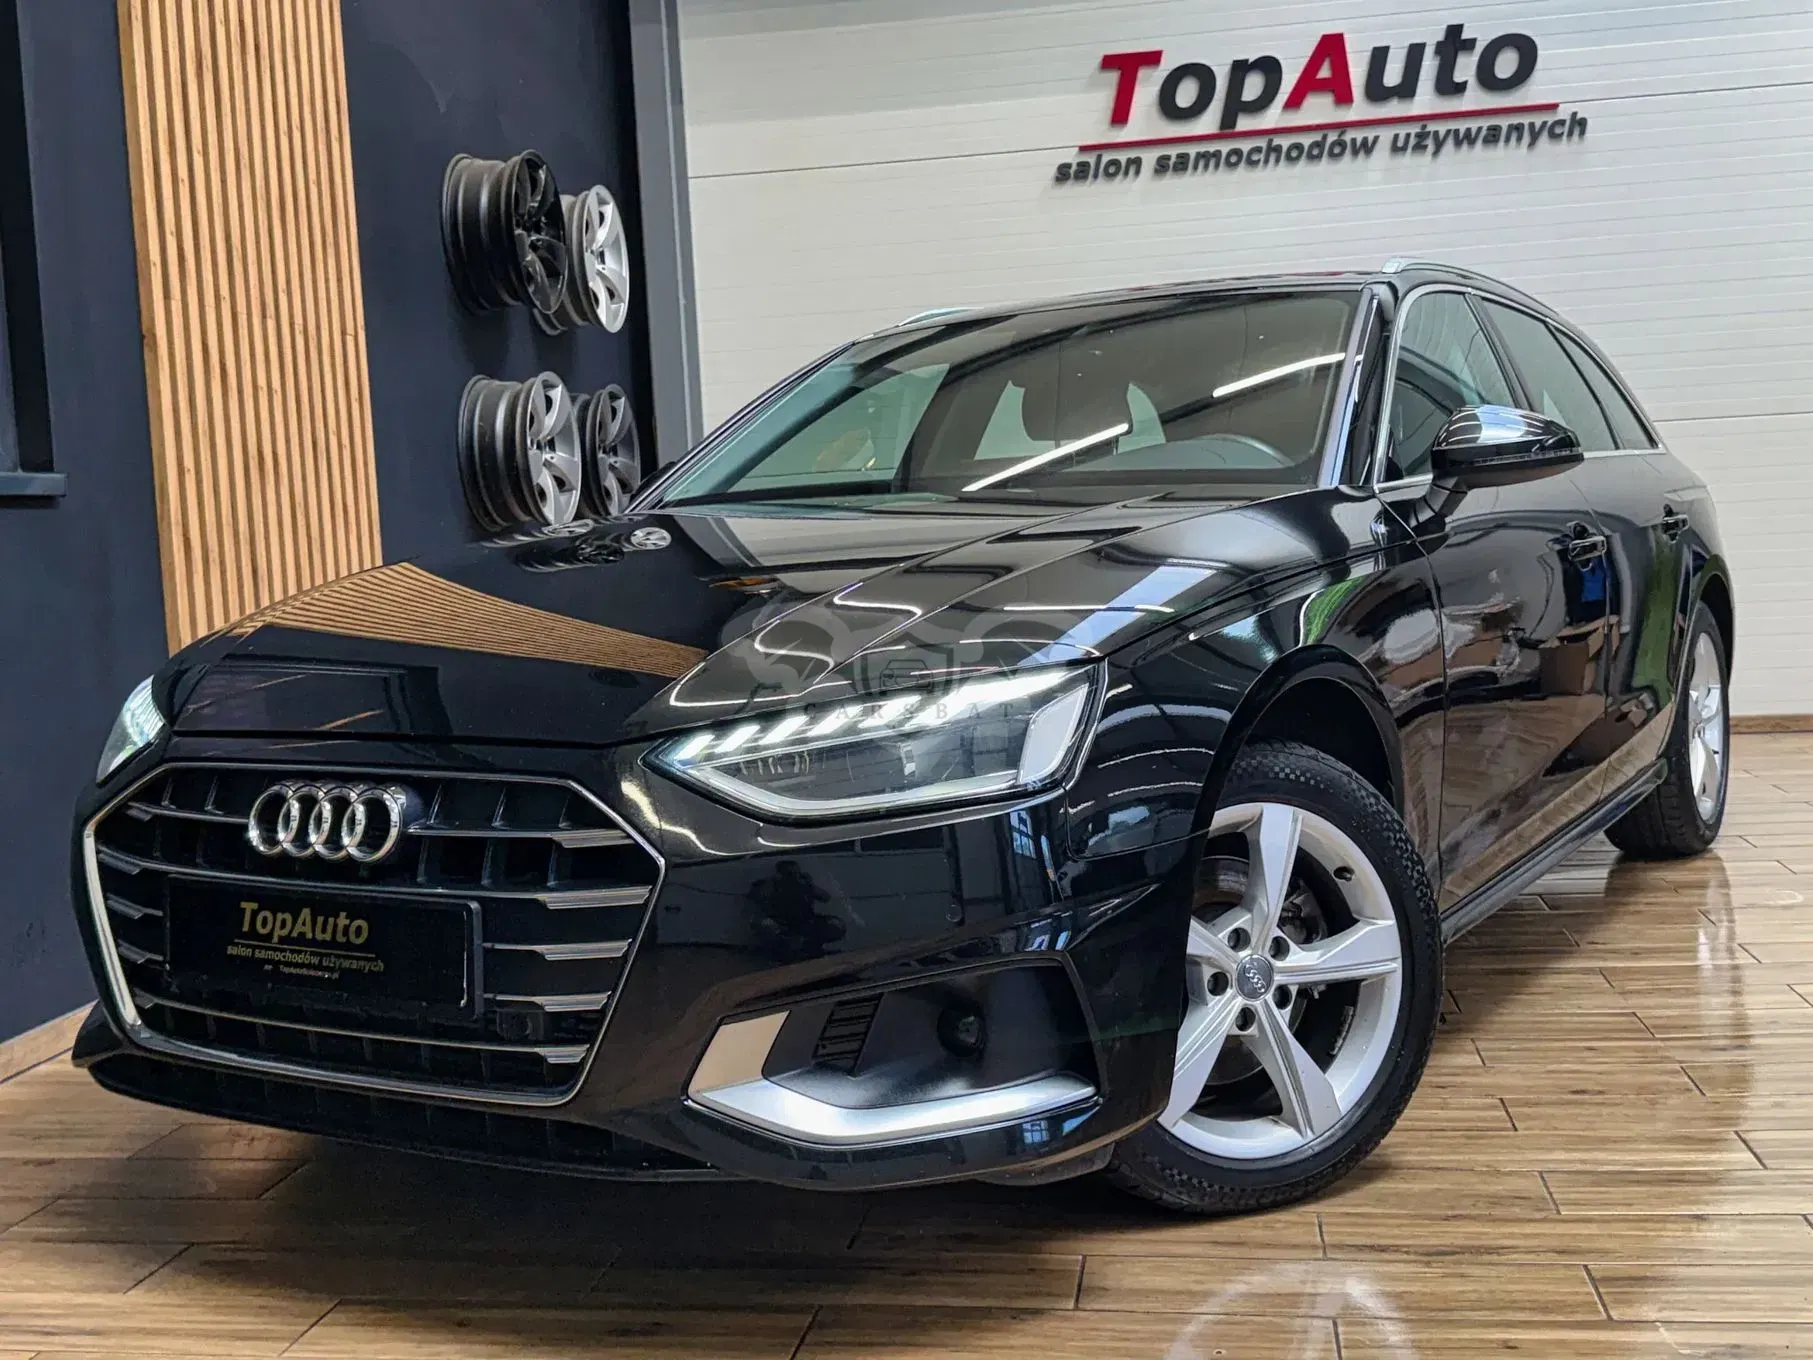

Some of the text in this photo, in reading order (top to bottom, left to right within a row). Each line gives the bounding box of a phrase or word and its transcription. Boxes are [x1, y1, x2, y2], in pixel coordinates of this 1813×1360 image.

[1100, 23, 1538, 131] TopAuto
[1054, 112, 1588, 183] salon samochodów używanych
[240, 901, 369, 945] TopAuto
[226, 944, 252, 957] salon
[254, 949, 320, 966] samochodów
[322, 955, 384, 973] używanych
